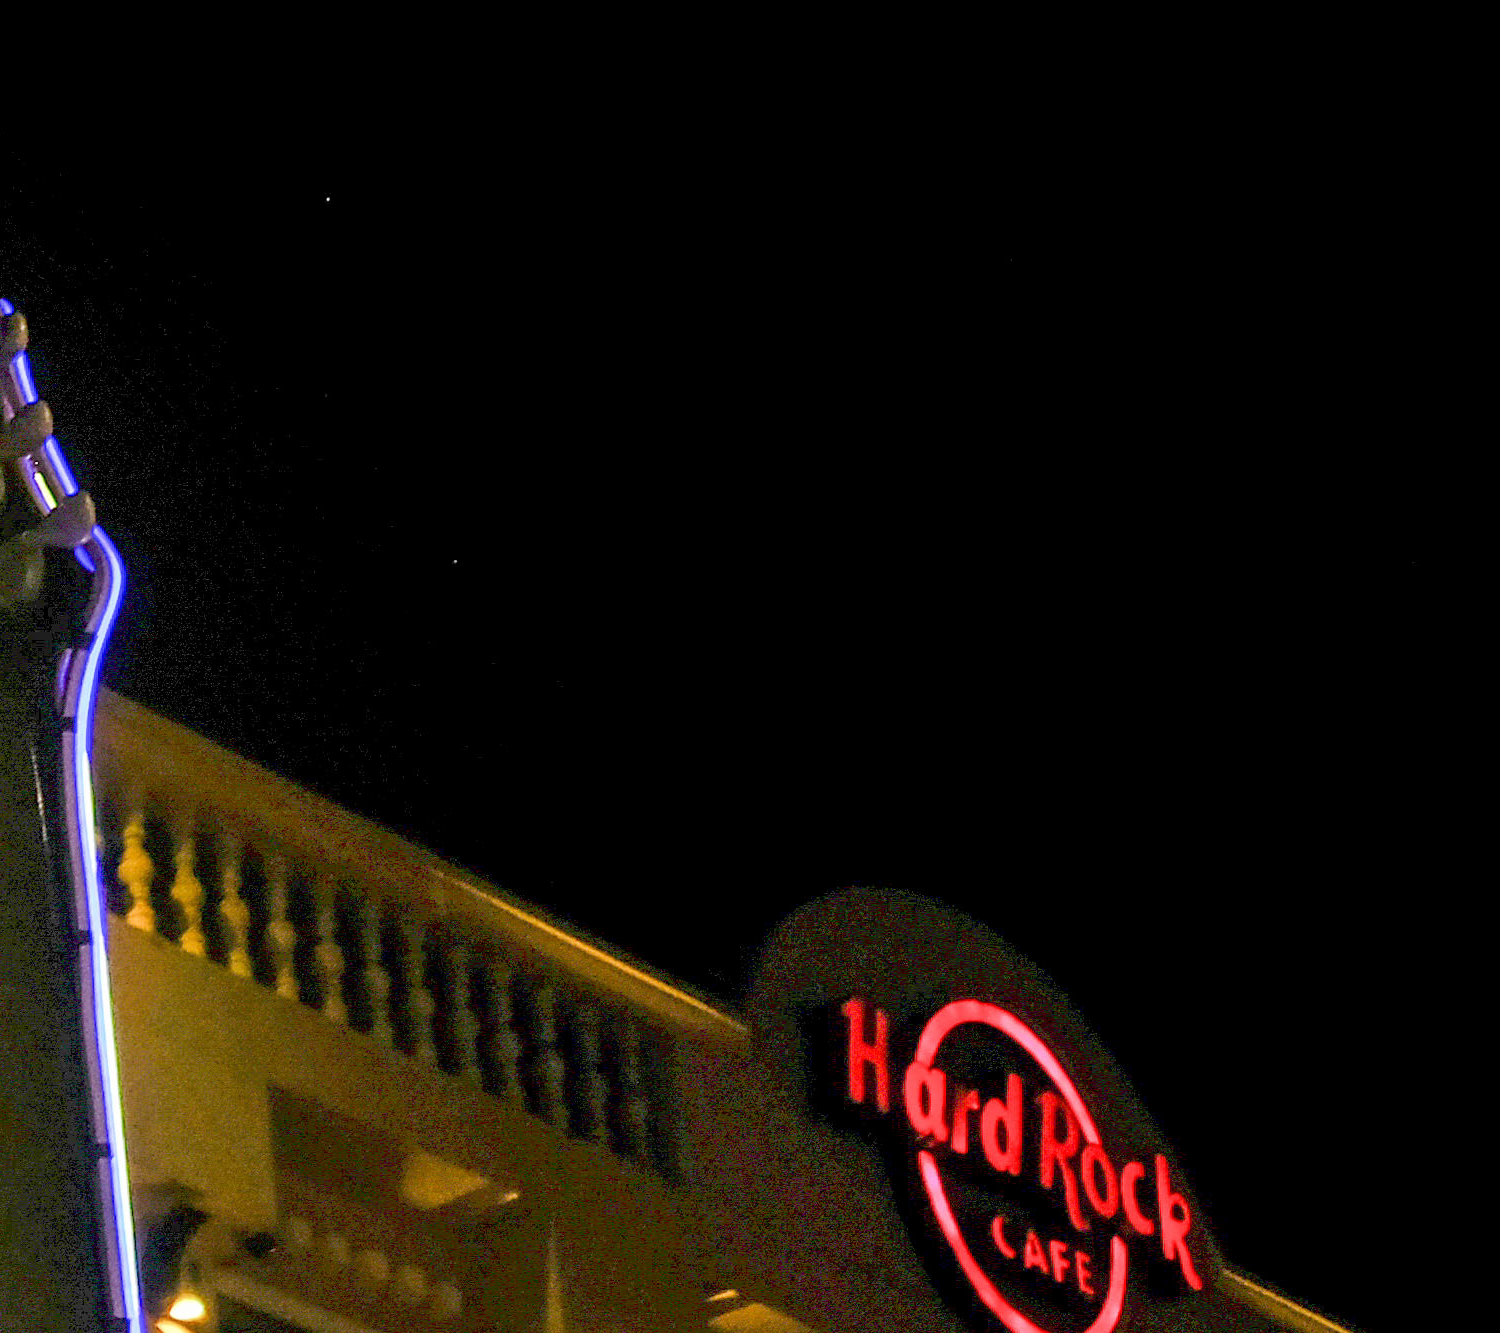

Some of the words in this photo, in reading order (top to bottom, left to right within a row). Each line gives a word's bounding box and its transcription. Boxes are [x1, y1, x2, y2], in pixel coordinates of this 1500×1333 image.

[841, 998, 1024, 1177] Hard
[1036, 1090, 1203, 1291] Rock
[991, 1215, 1095, 1296] CAFE
